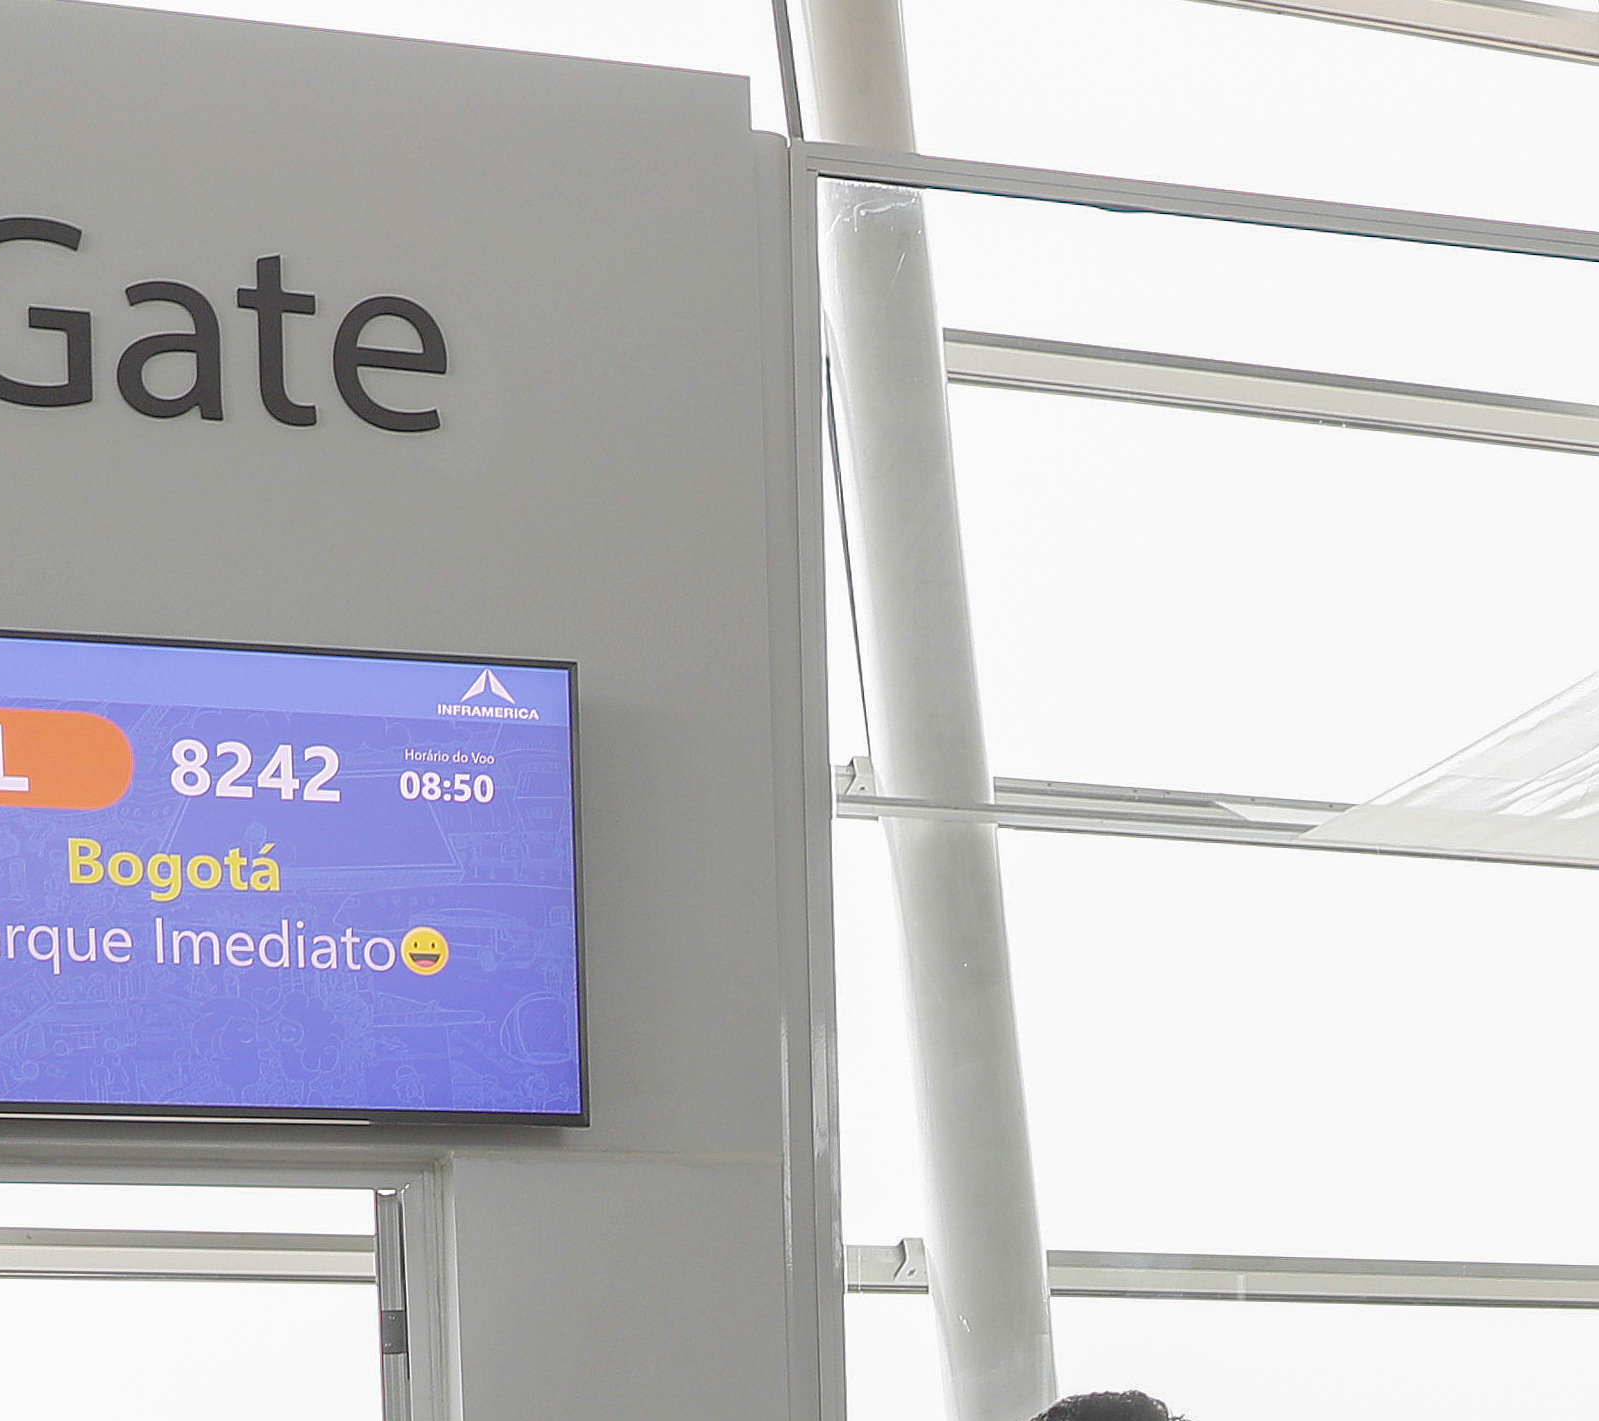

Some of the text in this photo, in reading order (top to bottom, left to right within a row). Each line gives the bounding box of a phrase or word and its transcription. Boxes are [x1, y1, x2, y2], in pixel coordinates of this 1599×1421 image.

[436, 703, 540, 721] INFRAMERICA
[169, 739, 342, 803] 8242
[405, 749, 449, 763] Horário
[453, 750, 468, 764] do
[400, 770, 495, 803] 08:50
[68, 836, 282, 902] Bogotá
[155, 918, 396, 975] Imediato
